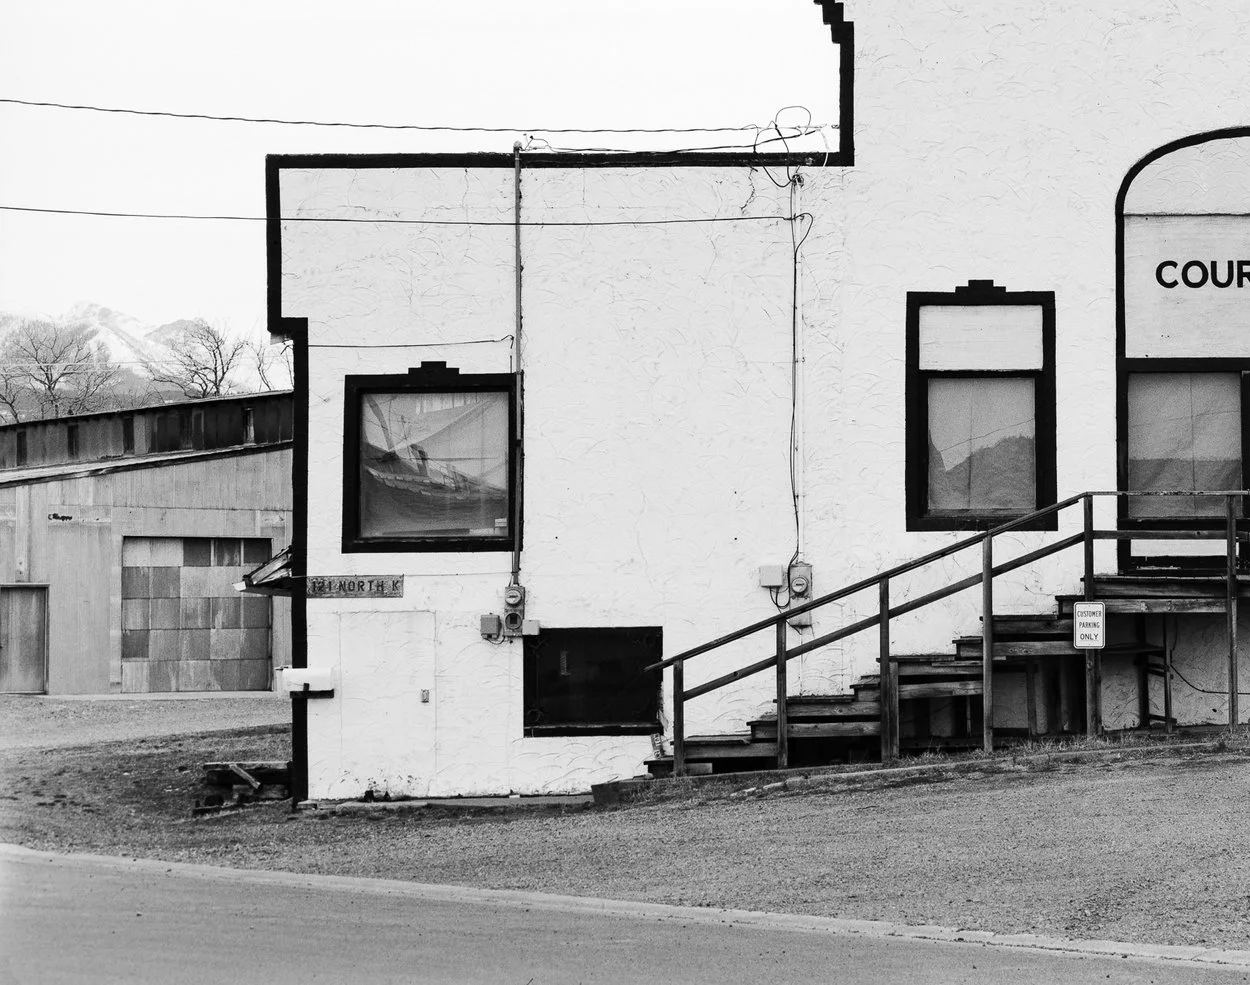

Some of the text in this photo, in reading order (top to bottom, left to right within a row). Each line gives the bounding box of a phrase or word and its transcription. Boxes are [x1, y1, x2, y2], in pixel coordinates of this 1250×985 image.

[311, 580, 400, 592] 121 NORTH K
